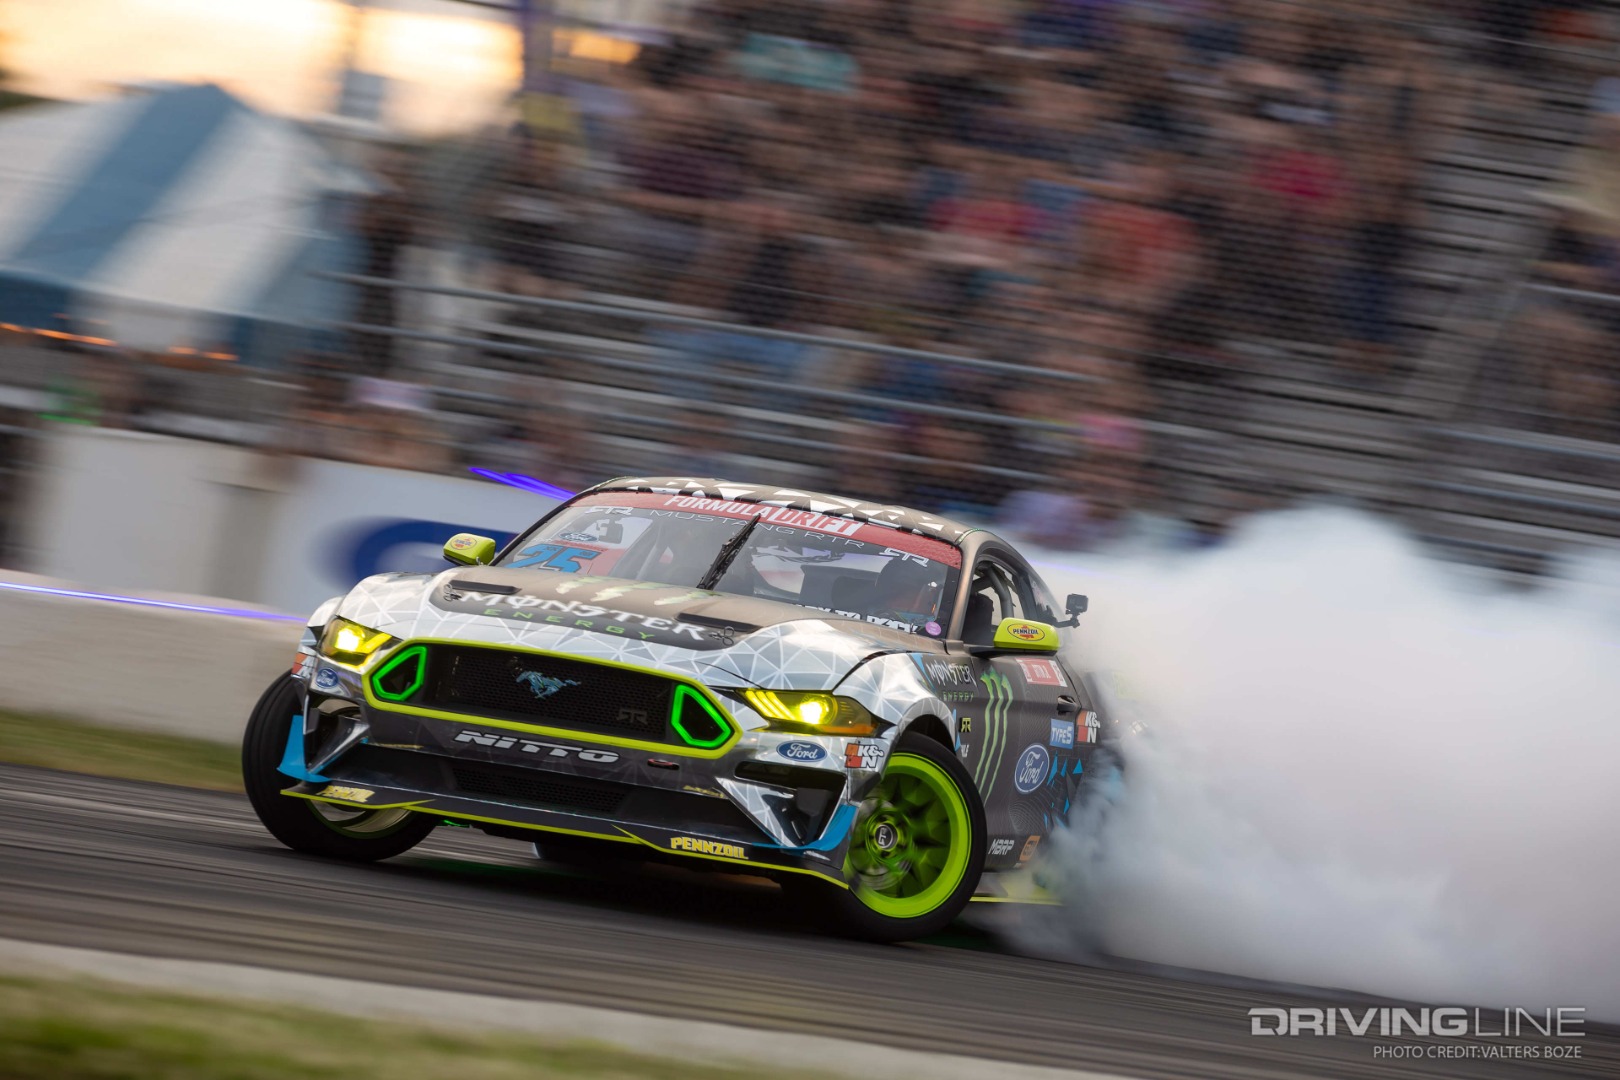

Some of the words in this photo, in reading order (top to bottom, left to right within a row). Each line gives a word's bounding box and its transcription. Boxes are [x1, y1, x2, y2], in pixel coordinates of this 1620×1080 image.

[664, 495, 769, 518] FORMULA
[767, 506, 865, 536] DRIFT
[804, 531, 865, 548] RTR
[503, 543, 602, 573] 25
[484, 608, 656, 640] ENERGY
[942, 691, 975, 701] ENERGY
[454, 730, 620, 763] NITTO
[786, 743, 818, 760] Ford
[1018, 751, 1045, 785] Ford
[670, 836, 749, 860] PENNZOIL
